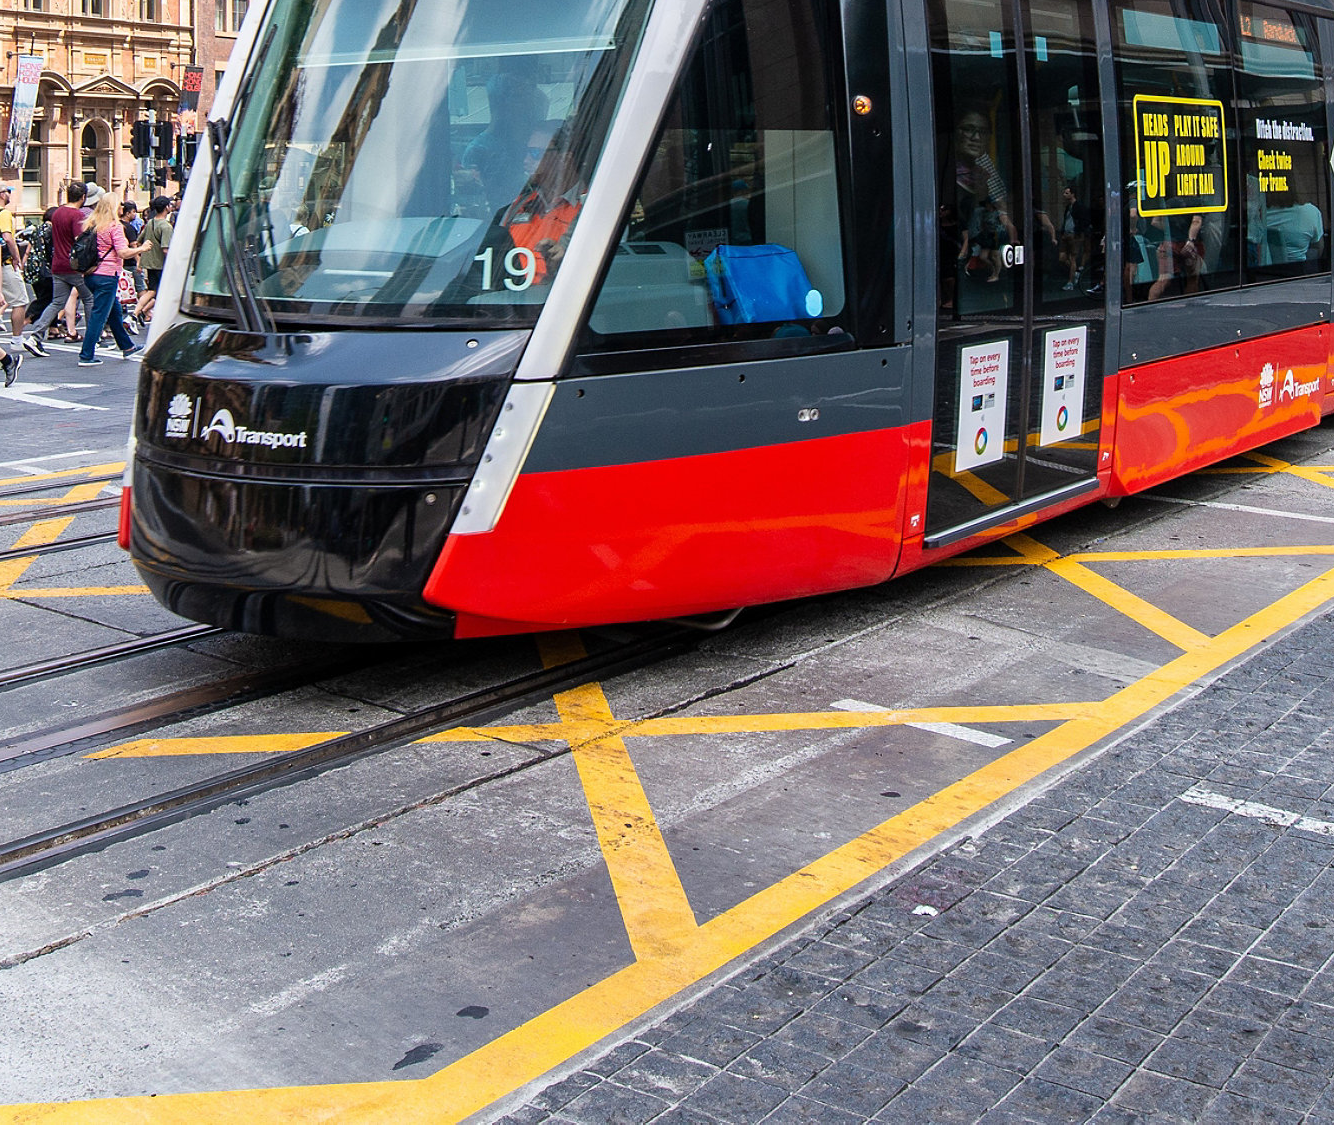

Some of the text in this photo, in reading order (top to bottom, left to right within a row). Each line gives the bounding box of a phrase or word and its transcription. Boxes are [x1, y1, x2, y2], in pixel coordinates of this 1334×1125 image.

[1240, 15, 1252, 36] L2
[1142, 113, 1169, 137] HEADS
[1174, 114, 1219, 138] PLAY IT SAFE
[1256, 118, 1315, 142] Ditch the distraction.
[1176, 144, 1205, 167] AROUND
[1257, 148, 1292, 171] Check twice
[1143, 140, 1171, 199] UP
[1176, 173, 1216, 196] LIGHT RAIL
[1258, 171, 1289, 193] for trams.
[473, 247, 537, 292] 19
[1052, 336, 1080, 349] Tap on every
[1052, 347, 1079, 359] time before
[969, 352, 1001, 366] Tap on every
[970, 363, 1000, 377] time before
[1055, 358, 1076, 369] boarding
[973, 376, 996, 388] boarding
[1293, 376, 1320, 398] Transport
[234, 425, 308, 450] Transport
